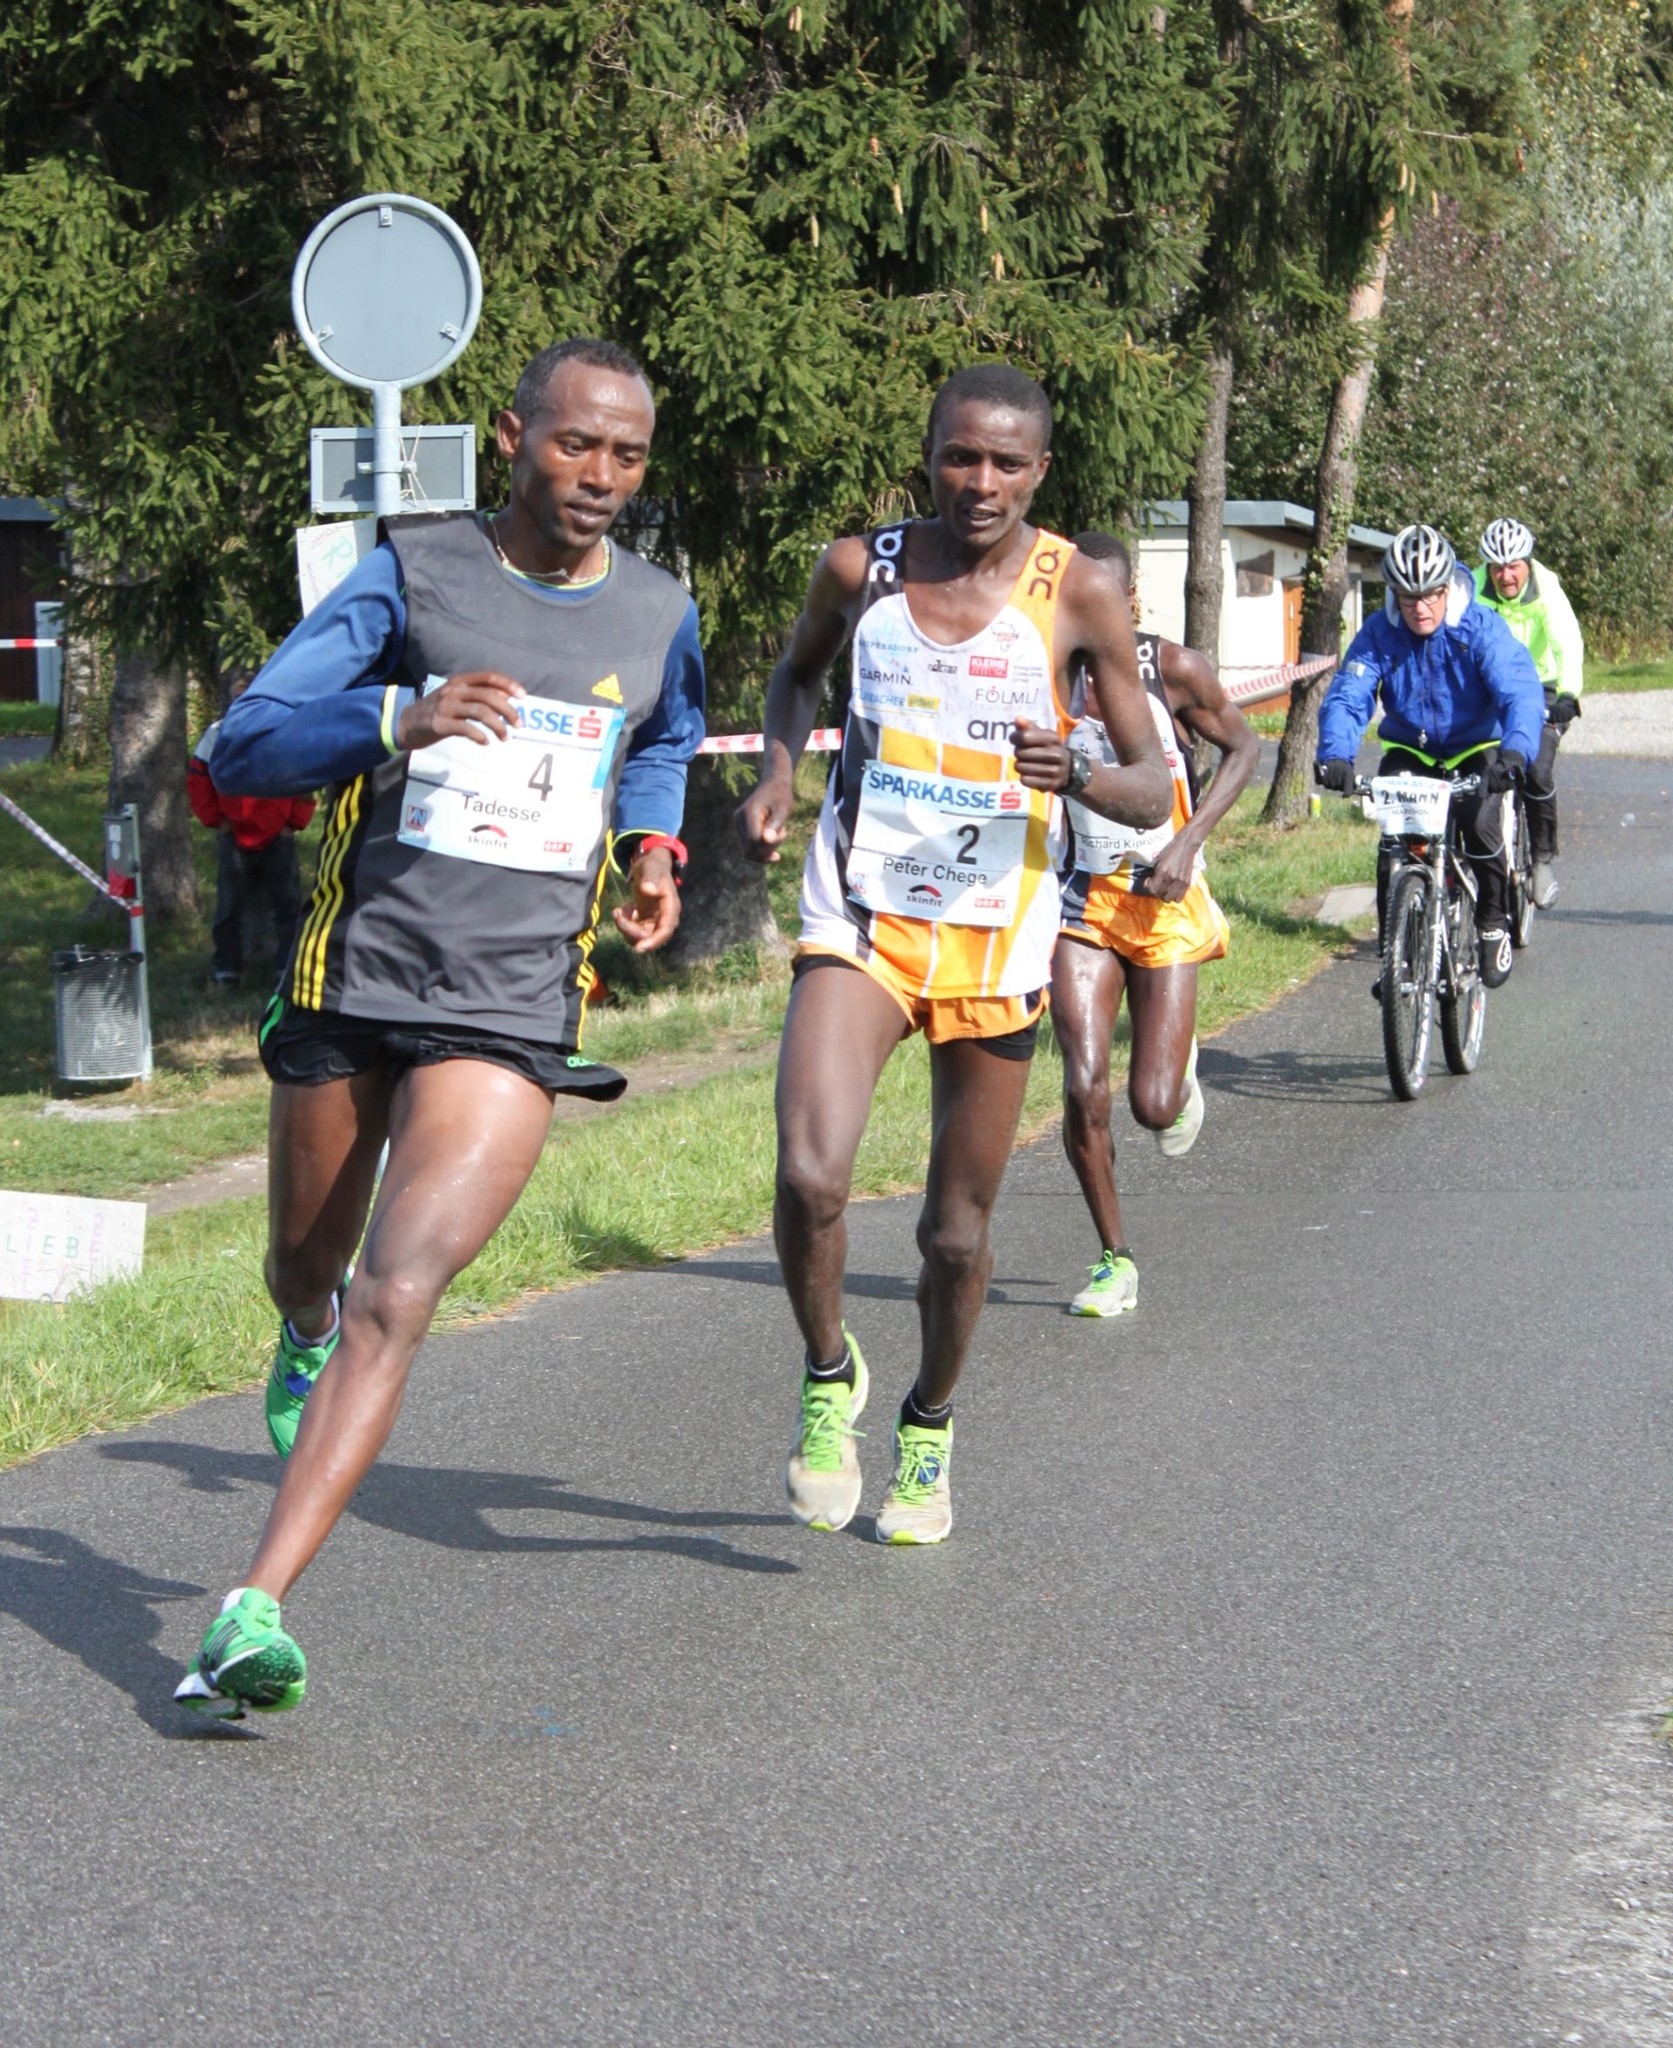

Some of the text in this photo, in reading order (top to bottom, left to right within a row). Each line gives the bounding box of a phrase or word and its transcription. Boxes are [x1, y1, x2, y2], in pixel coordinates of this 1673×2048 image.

[860, 667, 912, 686] GARMIN
[527, 753, 554, 802] 4
[868, 770, 998, 810] SPARKASSE
[461, 792, 542, 823] Tadesse
[467, 834, 510, 849] skinfit
[956, 823, 981, 866] 2
[883, 856, 988, 887] Peter Chege
[906, 894, 943, 908] skinfit
